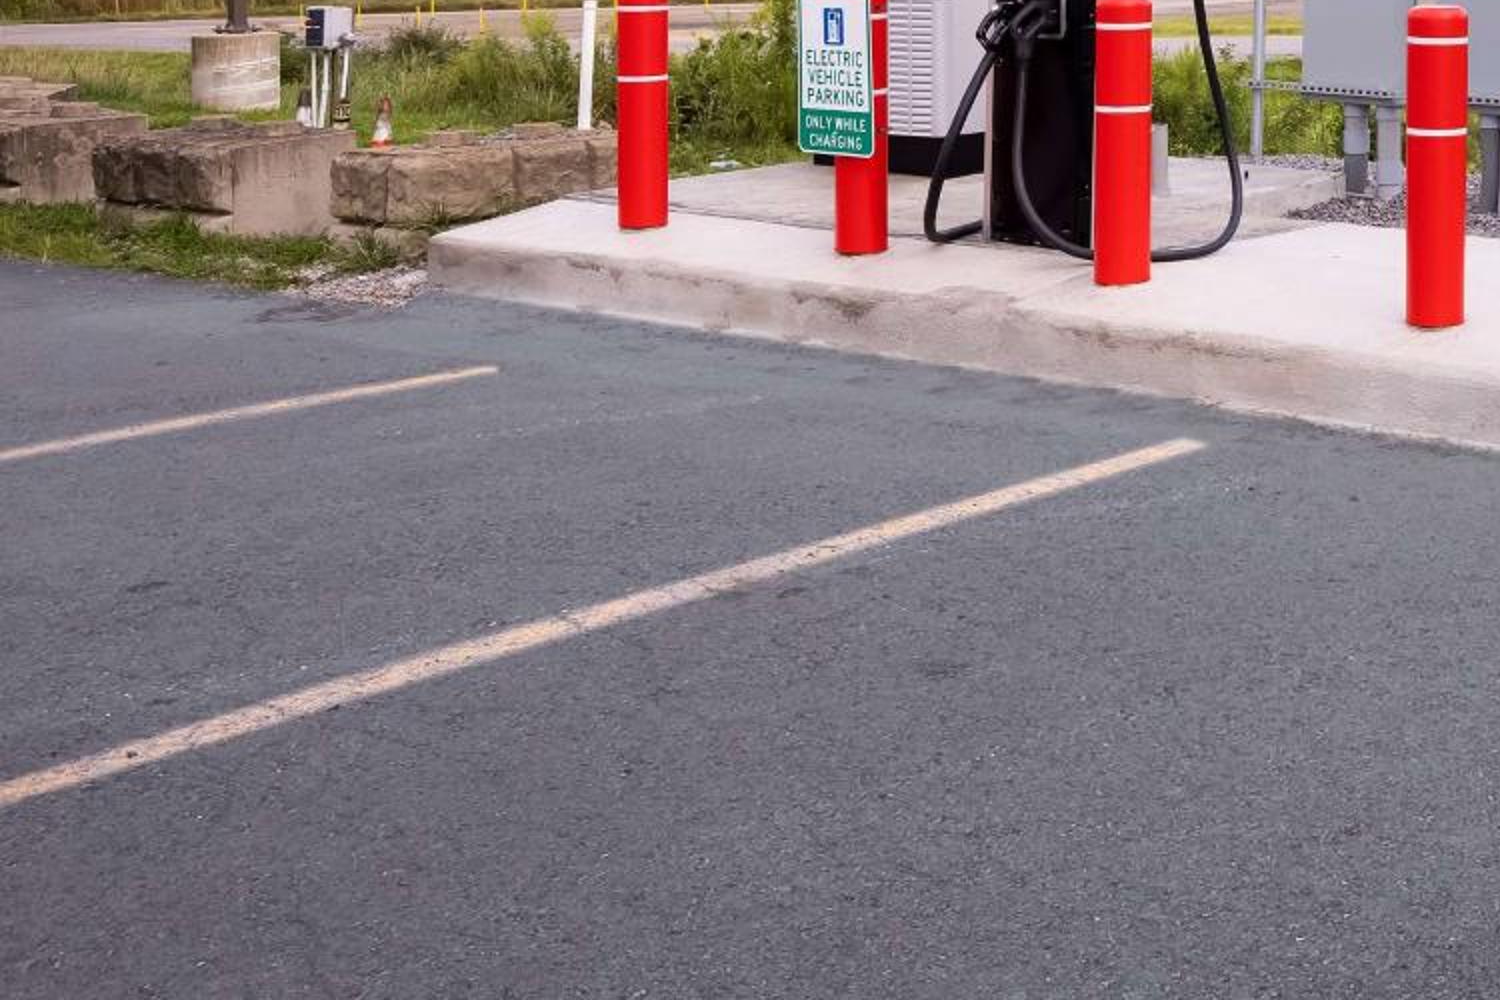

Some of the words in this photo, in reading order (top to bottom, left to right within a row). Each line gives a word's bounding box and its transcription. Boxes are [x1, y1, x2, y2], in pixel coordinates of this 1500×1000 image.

[806, 50, 863, 68] ELECTRIC
[807, 68, 863, 87] VEHICLE
[807, 88, 864, 107] PARKING
[805, 115, 833, 130] ONLY
[835, 118, 867, 133] WHILE
[809, 134, 863, 151] CHARGING
